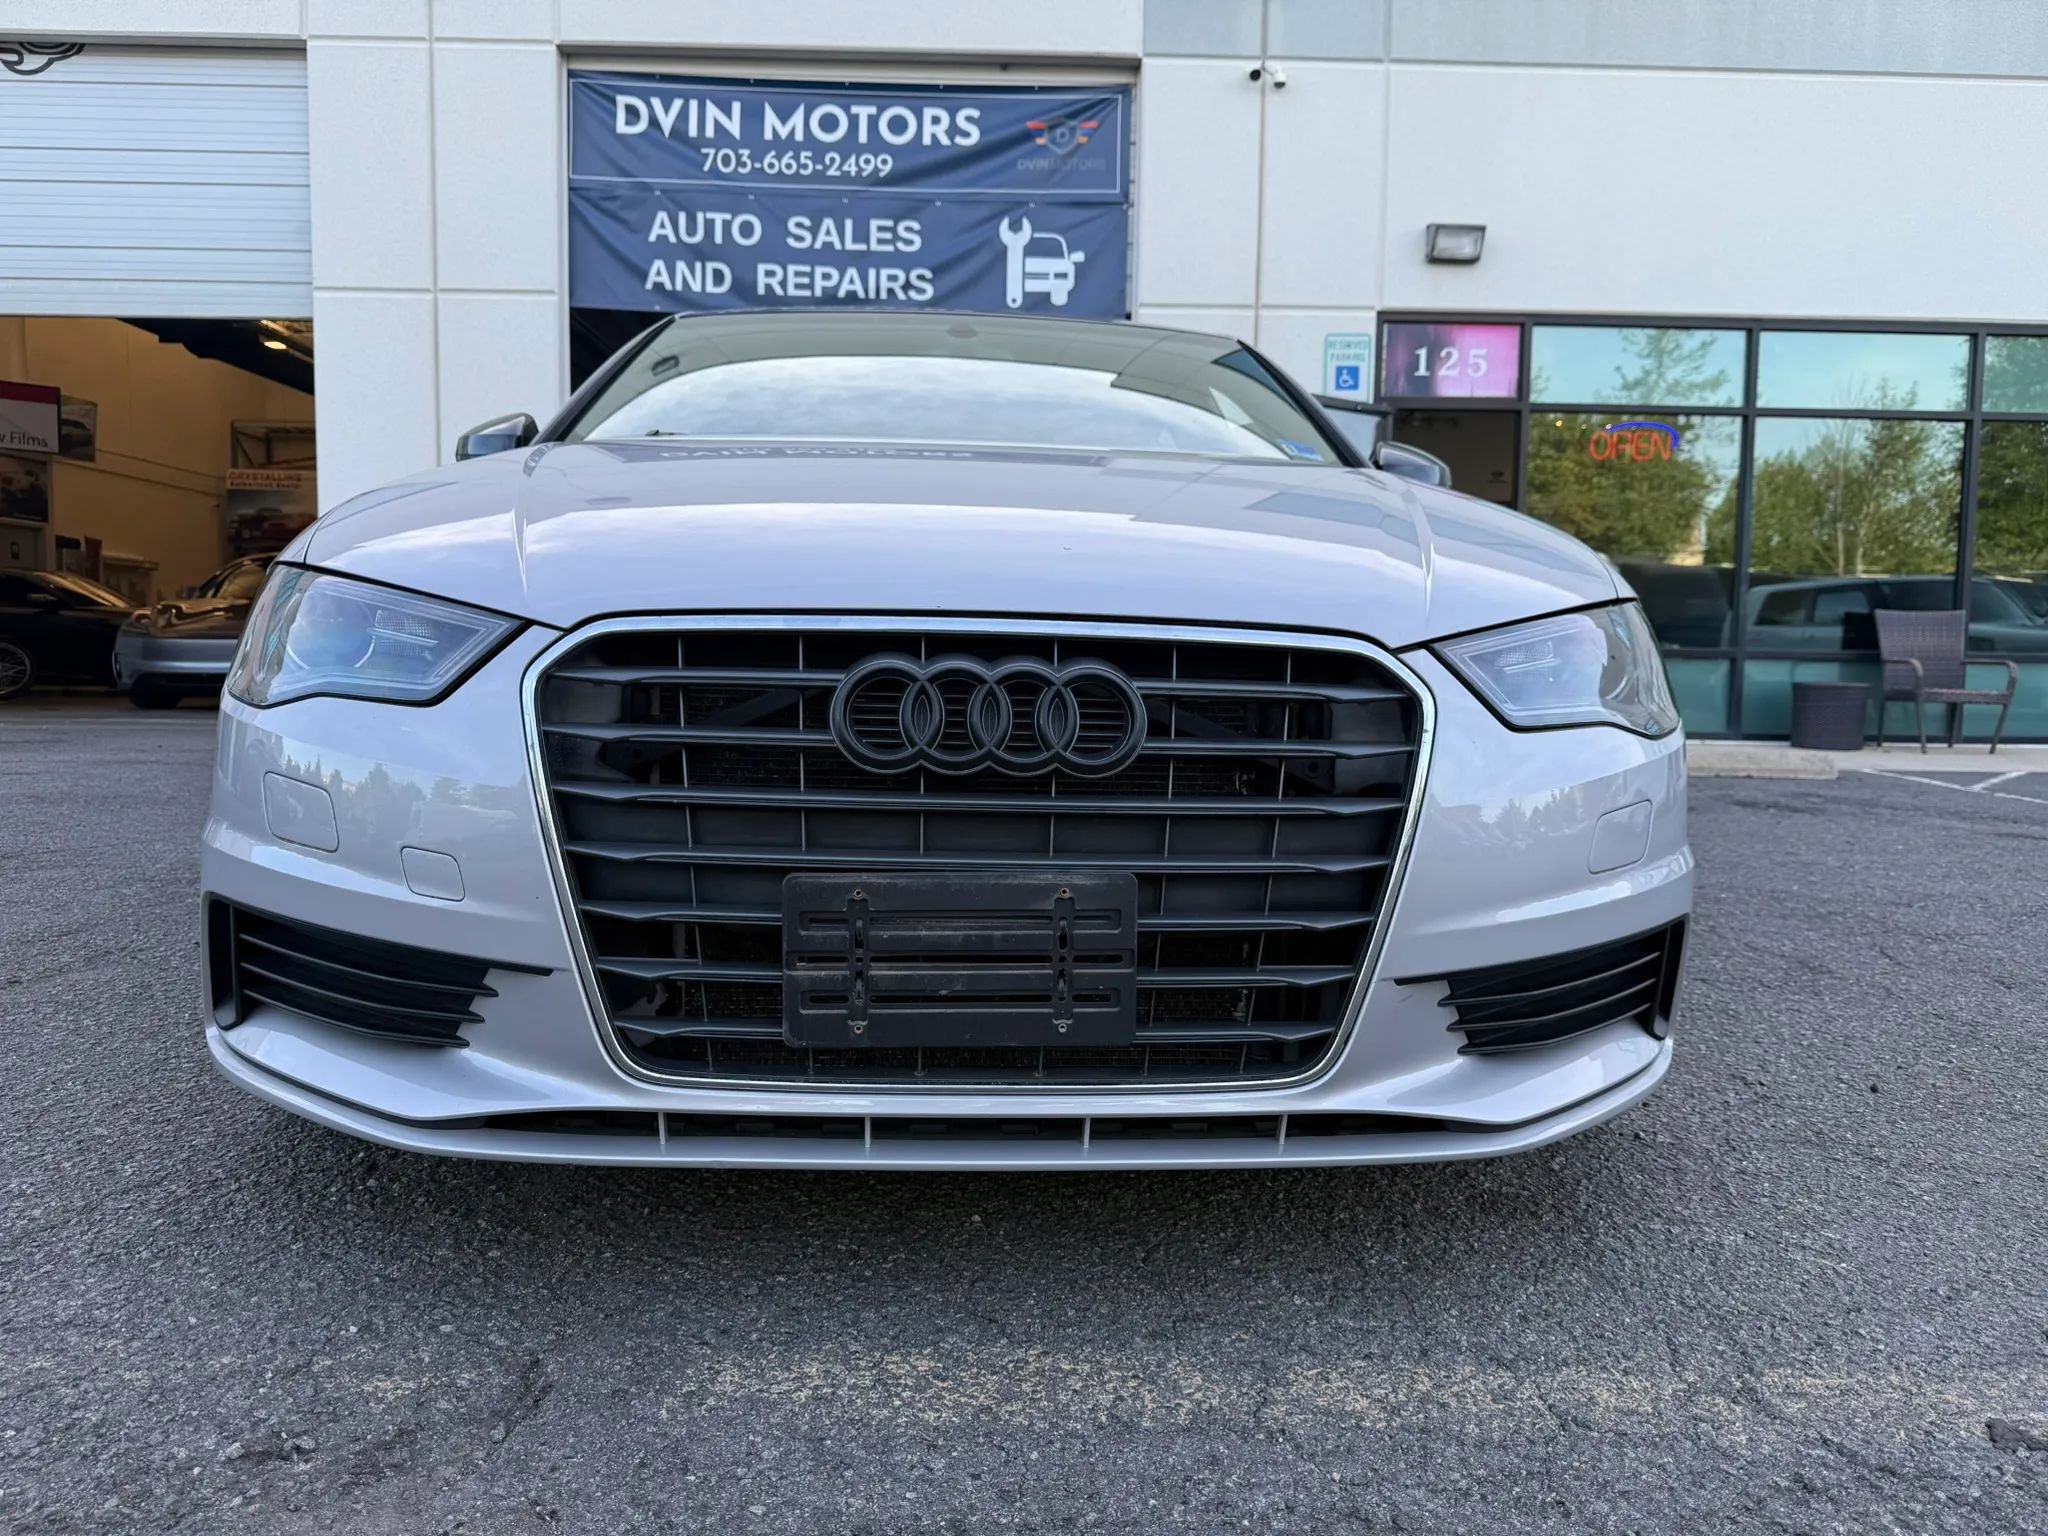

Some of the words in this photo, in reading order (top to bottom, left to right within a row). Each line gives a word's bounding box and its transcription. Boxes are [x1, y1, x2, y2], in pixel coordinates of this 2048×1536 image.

[615, 94, 742, 140] DVIN
[763, 102, 982, 146] MOTORS
[701, 148, 894, 178] 703-665-2499
[648, 209, 763, 247] AUTO
[785, 217, 923, 252] SALES
[645, 259, 733, 295] AND
[756, 263, 935, 300] REPAIRS
[1413, 345, 1489, 377] 125
[10, 431, 48, 448] Films
[1588, 430, 1674, 462] OPEN
